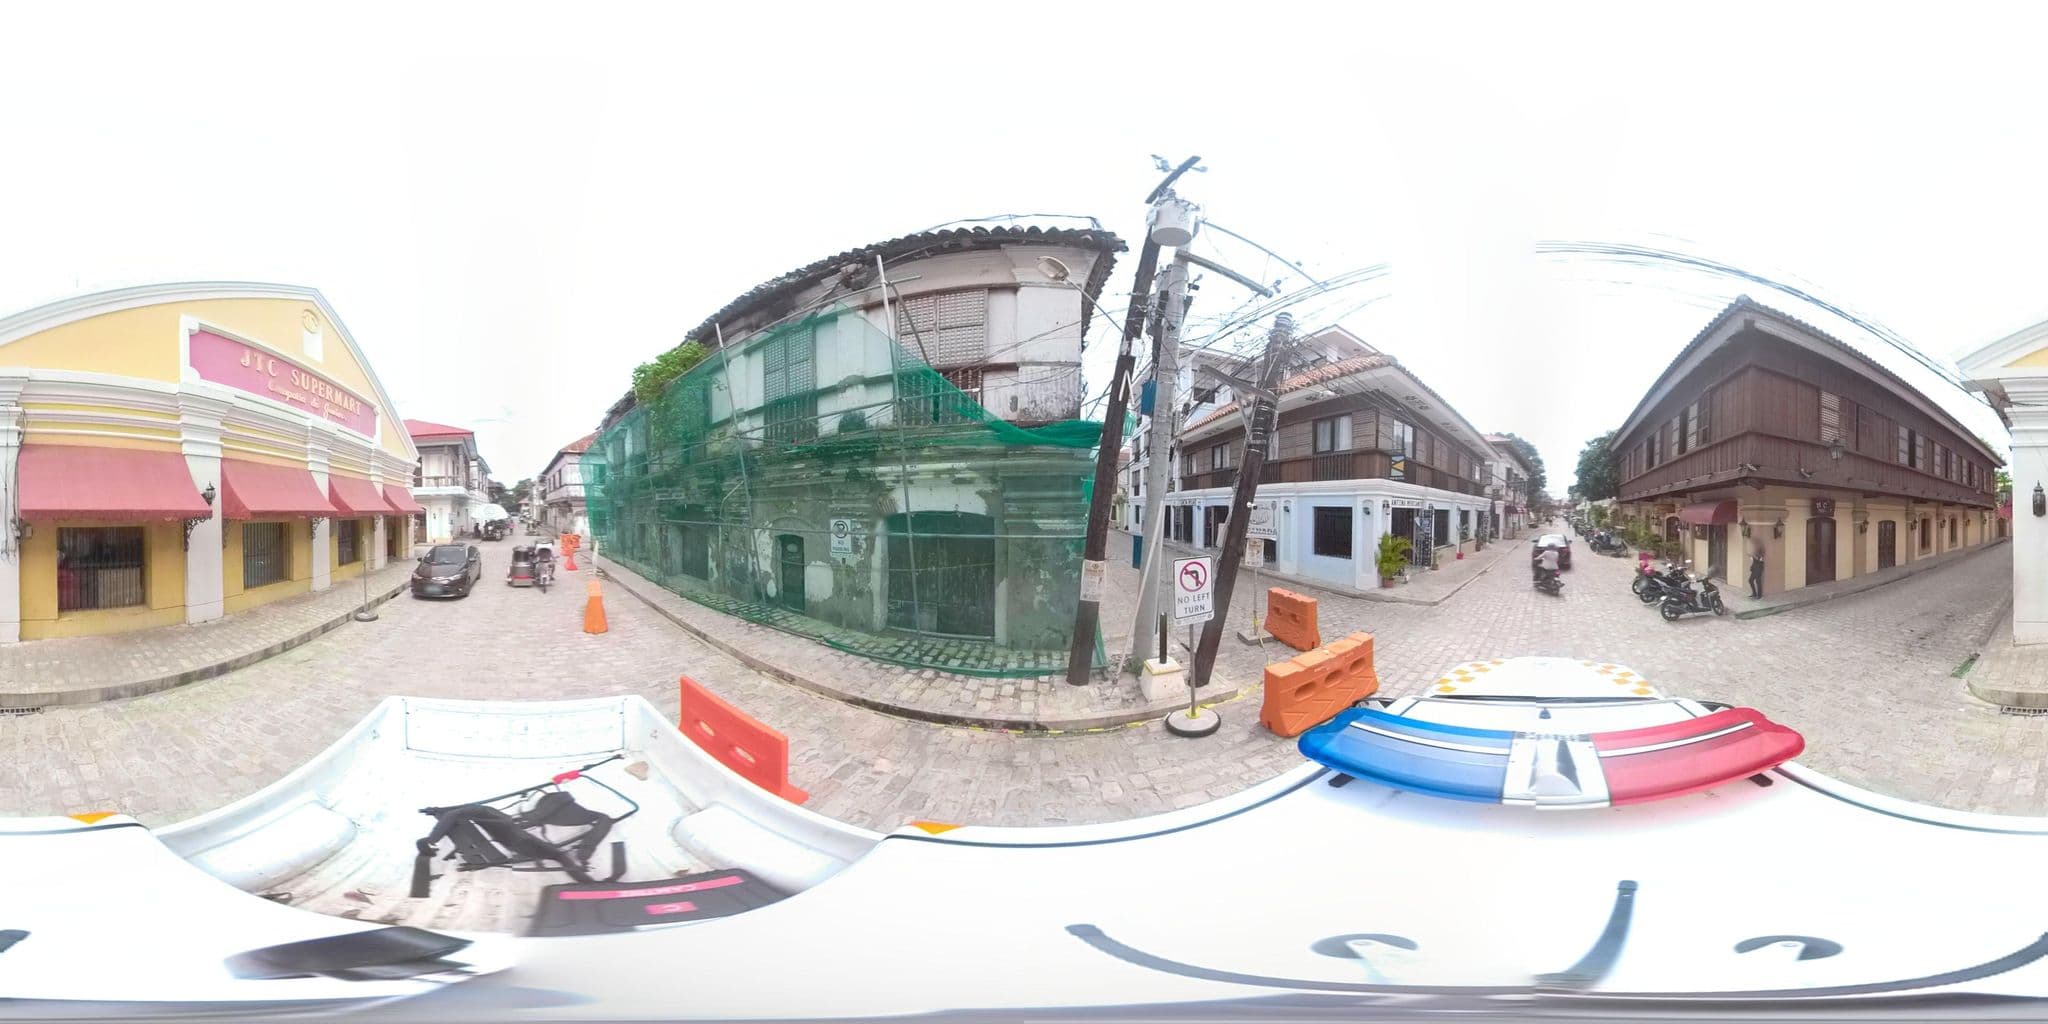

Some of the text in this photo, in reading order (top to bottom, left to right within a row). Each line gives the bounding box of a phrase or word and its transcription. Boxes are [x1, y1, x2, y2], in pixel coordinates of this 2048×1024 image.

[291, 369, 361, 416] SUPERMART
[1177, 592, 1209, 605] NO LEFT
[1184, 604, 1205, 614] TURN
